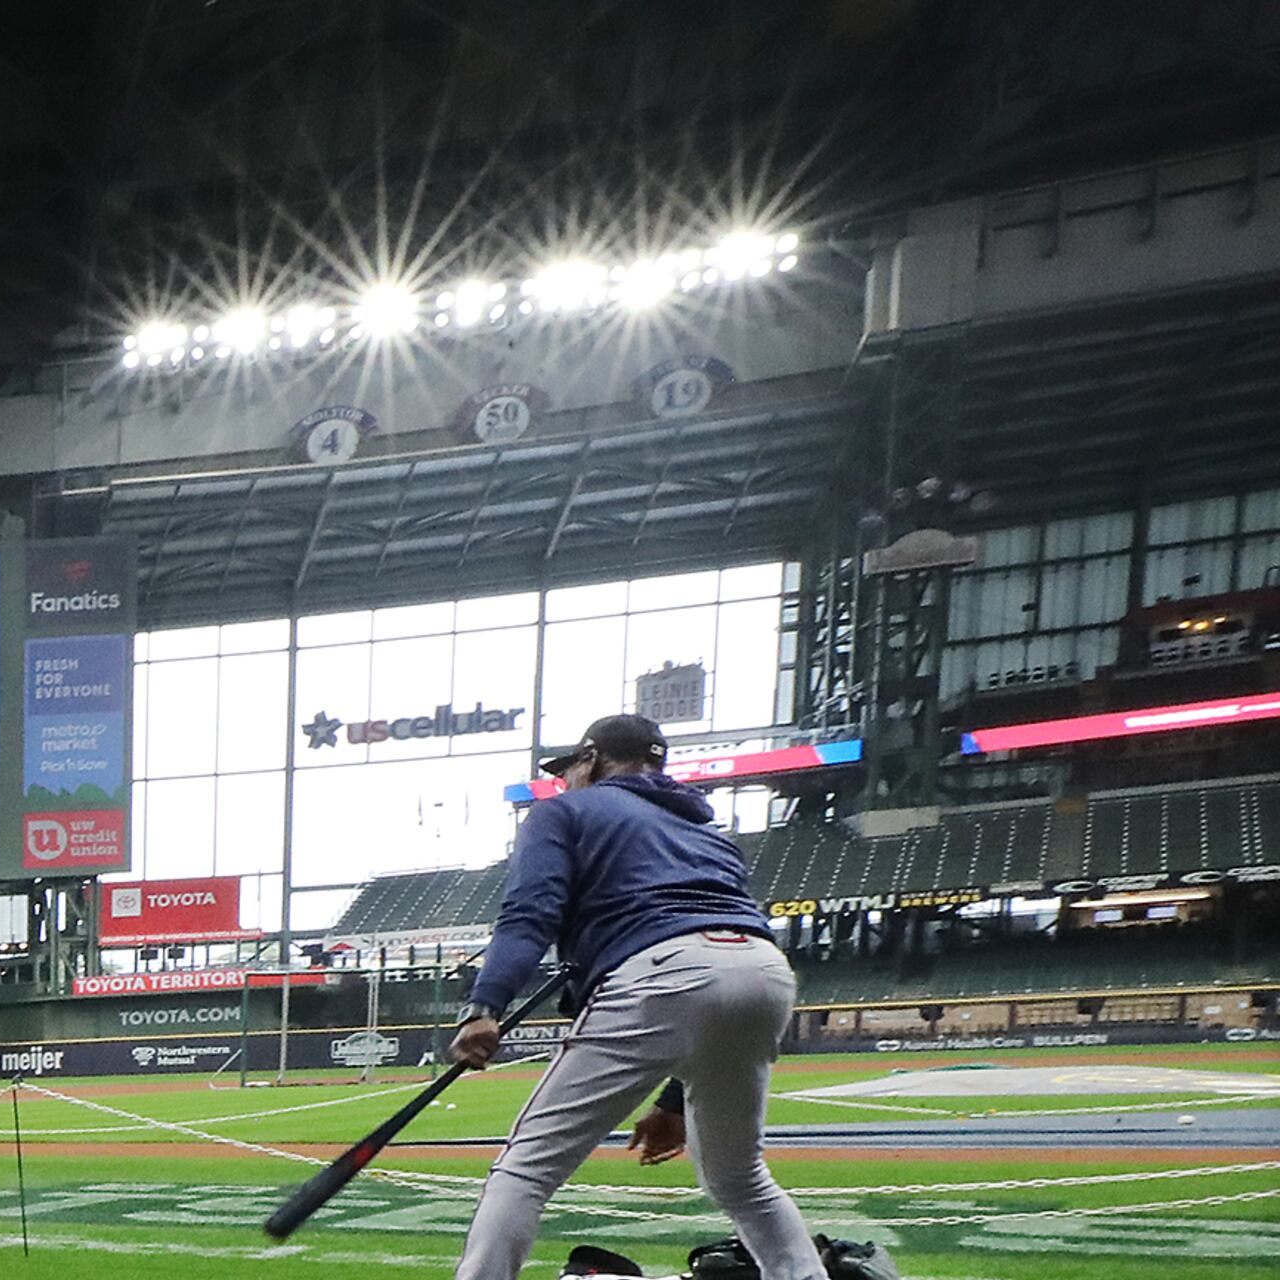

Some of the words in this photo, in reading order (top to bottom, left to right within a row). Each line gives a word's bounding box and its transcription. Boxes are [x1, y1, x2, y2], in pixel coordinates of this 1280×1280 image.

[321, 428, 340, 455] 4
[31, 589, 121, 613] Fanatics
[35, 659, 80, 673] FRESH
[35, 672, 64, 686] FOR
[35, 684, 112, 700] EVERYONE
[42, 738, 98, 752] market
[71, 830, 118, 843] credit
[71, 844, 119, 857] union
[147, 892, 216, 908] TOYOTA
[769, 900, 817, 917] 620
[819, 894, 895, 914] WTMJ
[76, 976, 146, 993] TOYOTA
[148, 970, 248, 990] TERRITORY
[120, 1006, 242, 1026] TOYOTA.COM
[157, 1046, 230, 1057] Northwestern
[1, 1047, 64, 1074] meijer
[157, 1055, 196, 1066] Mutual
